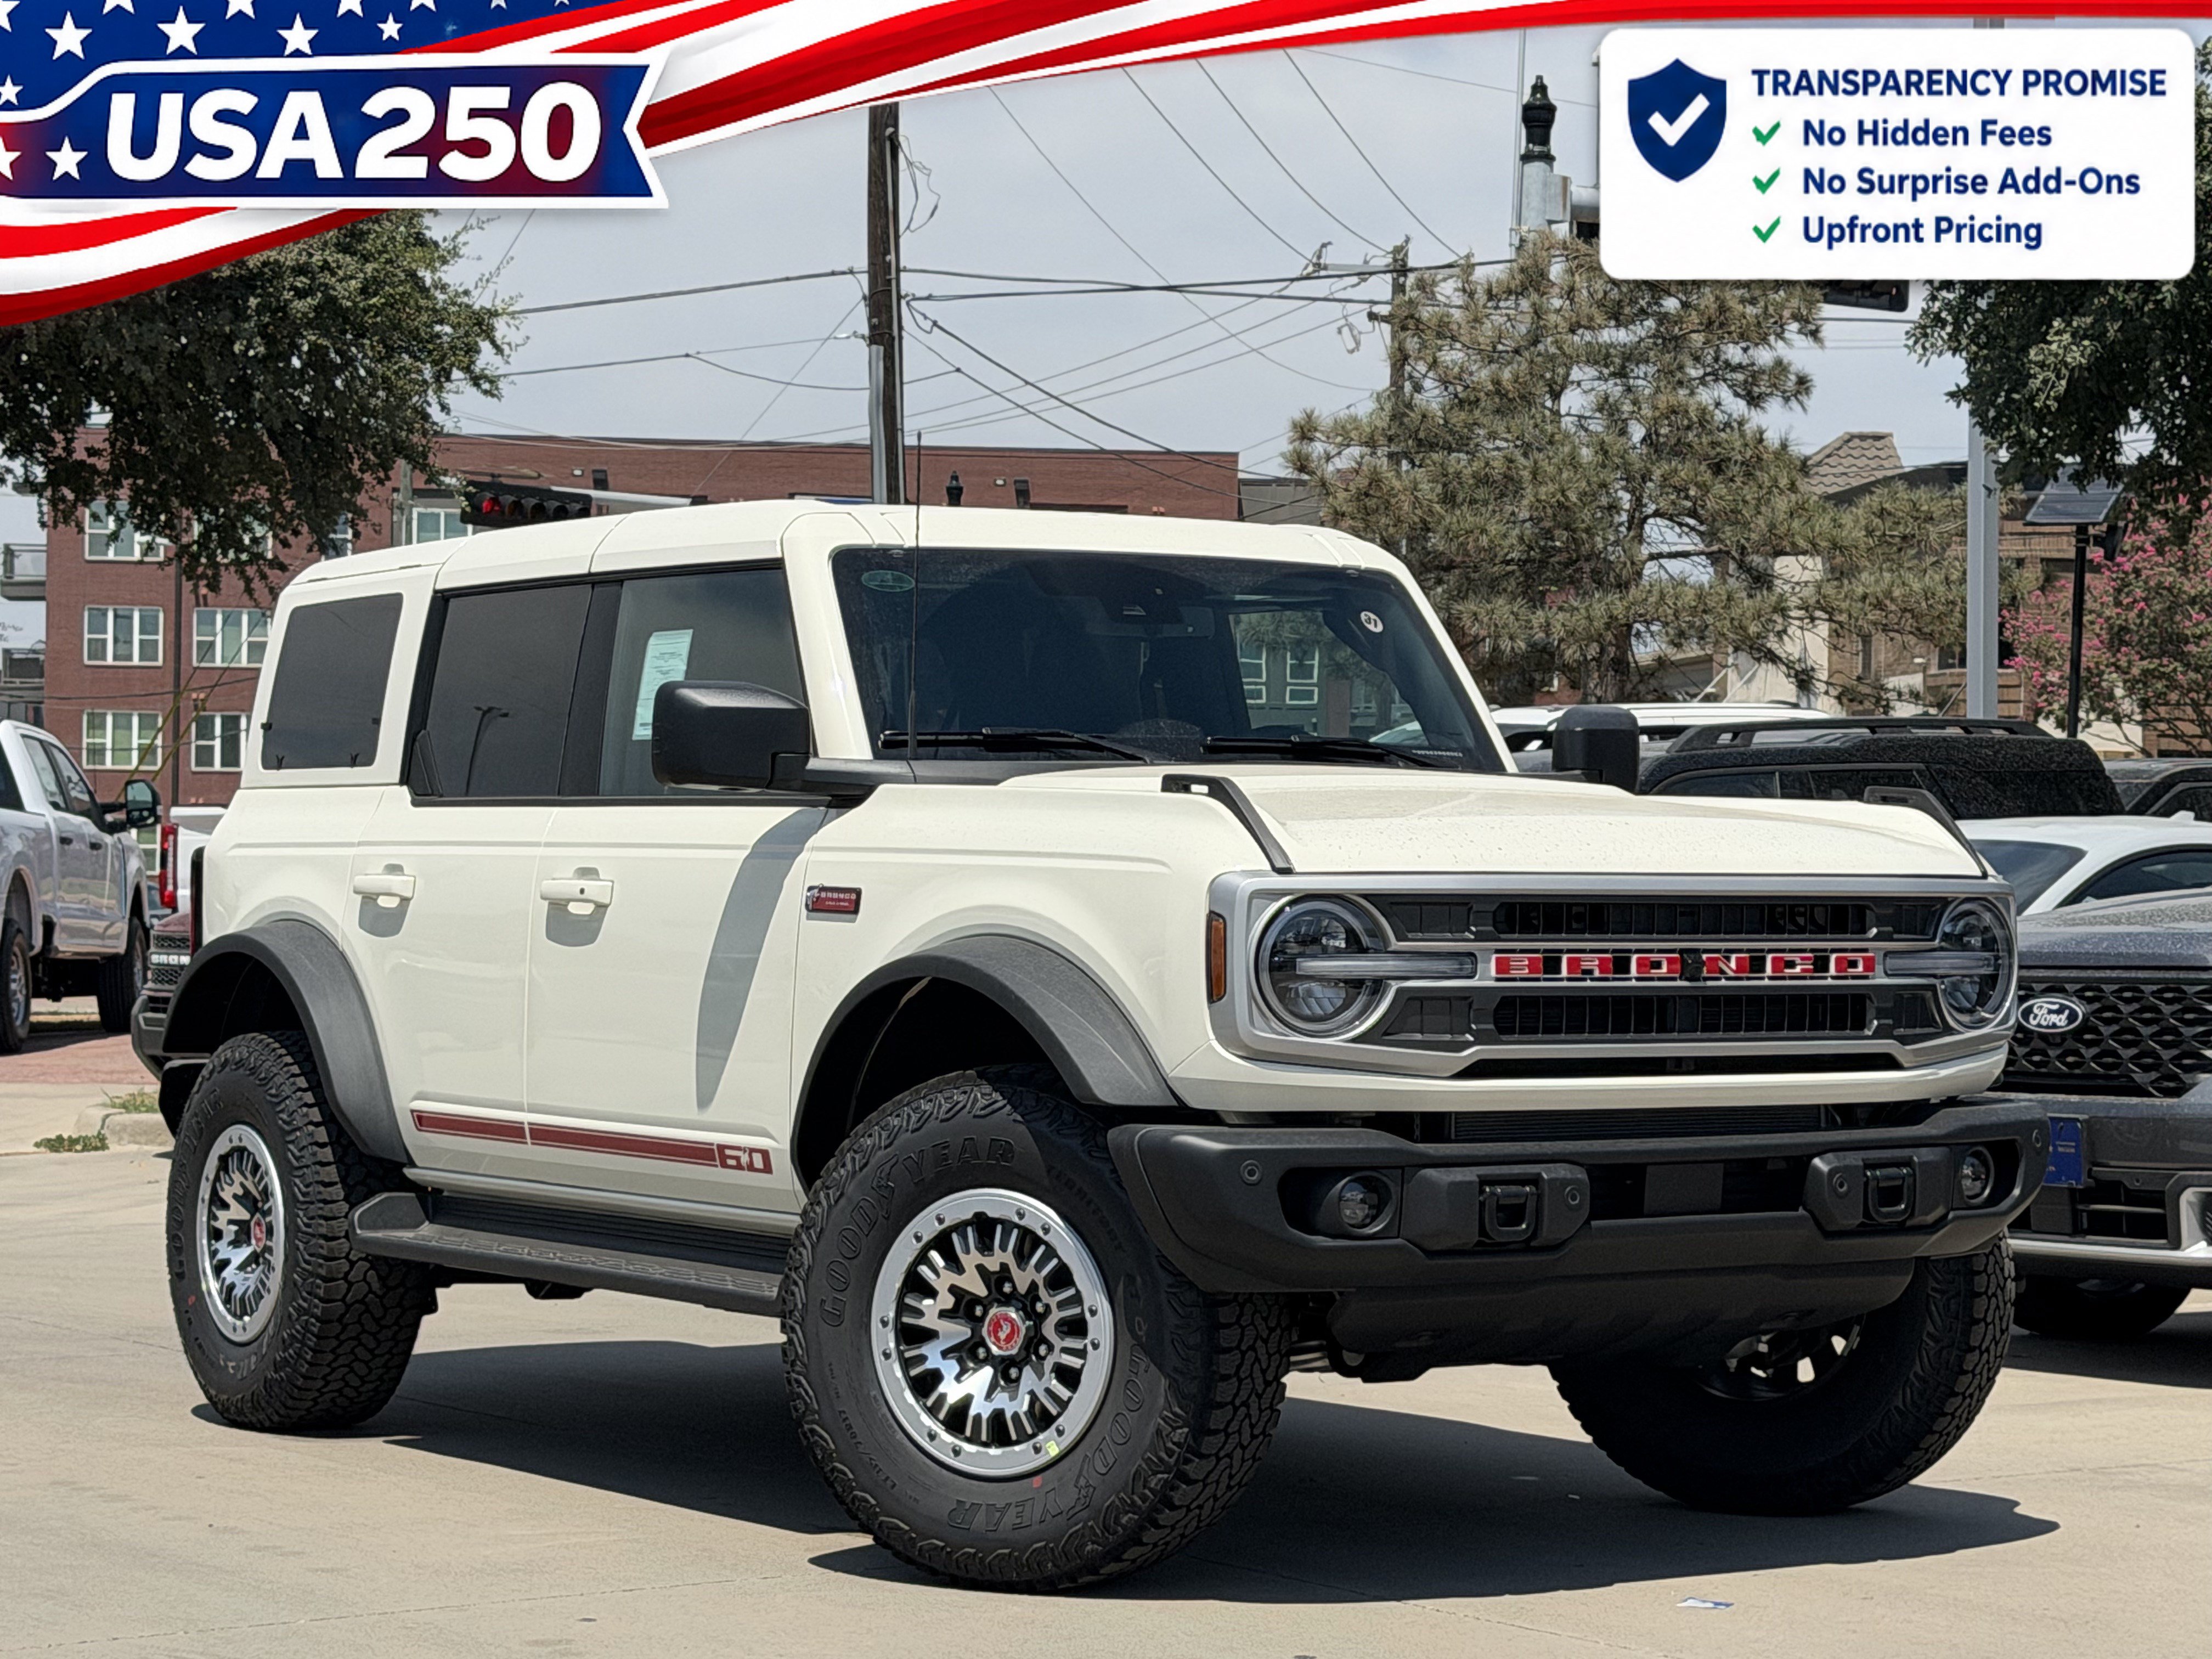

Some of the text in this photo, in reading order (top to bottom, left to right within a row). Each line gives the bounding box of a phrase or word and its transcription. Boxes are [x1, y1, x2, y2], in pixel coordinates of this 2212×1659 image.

[151, 953, 191, 966] BRON
[1491, 952, 1876, 977] BRONCO
[2029, 1002, 2070, 1026] Ford
[716, 1143, 774, 1175] 60
[819, 1135, 1017, 1328] GOODYEAR
[946, 1342, 1152, 1531] GOODYEAR
